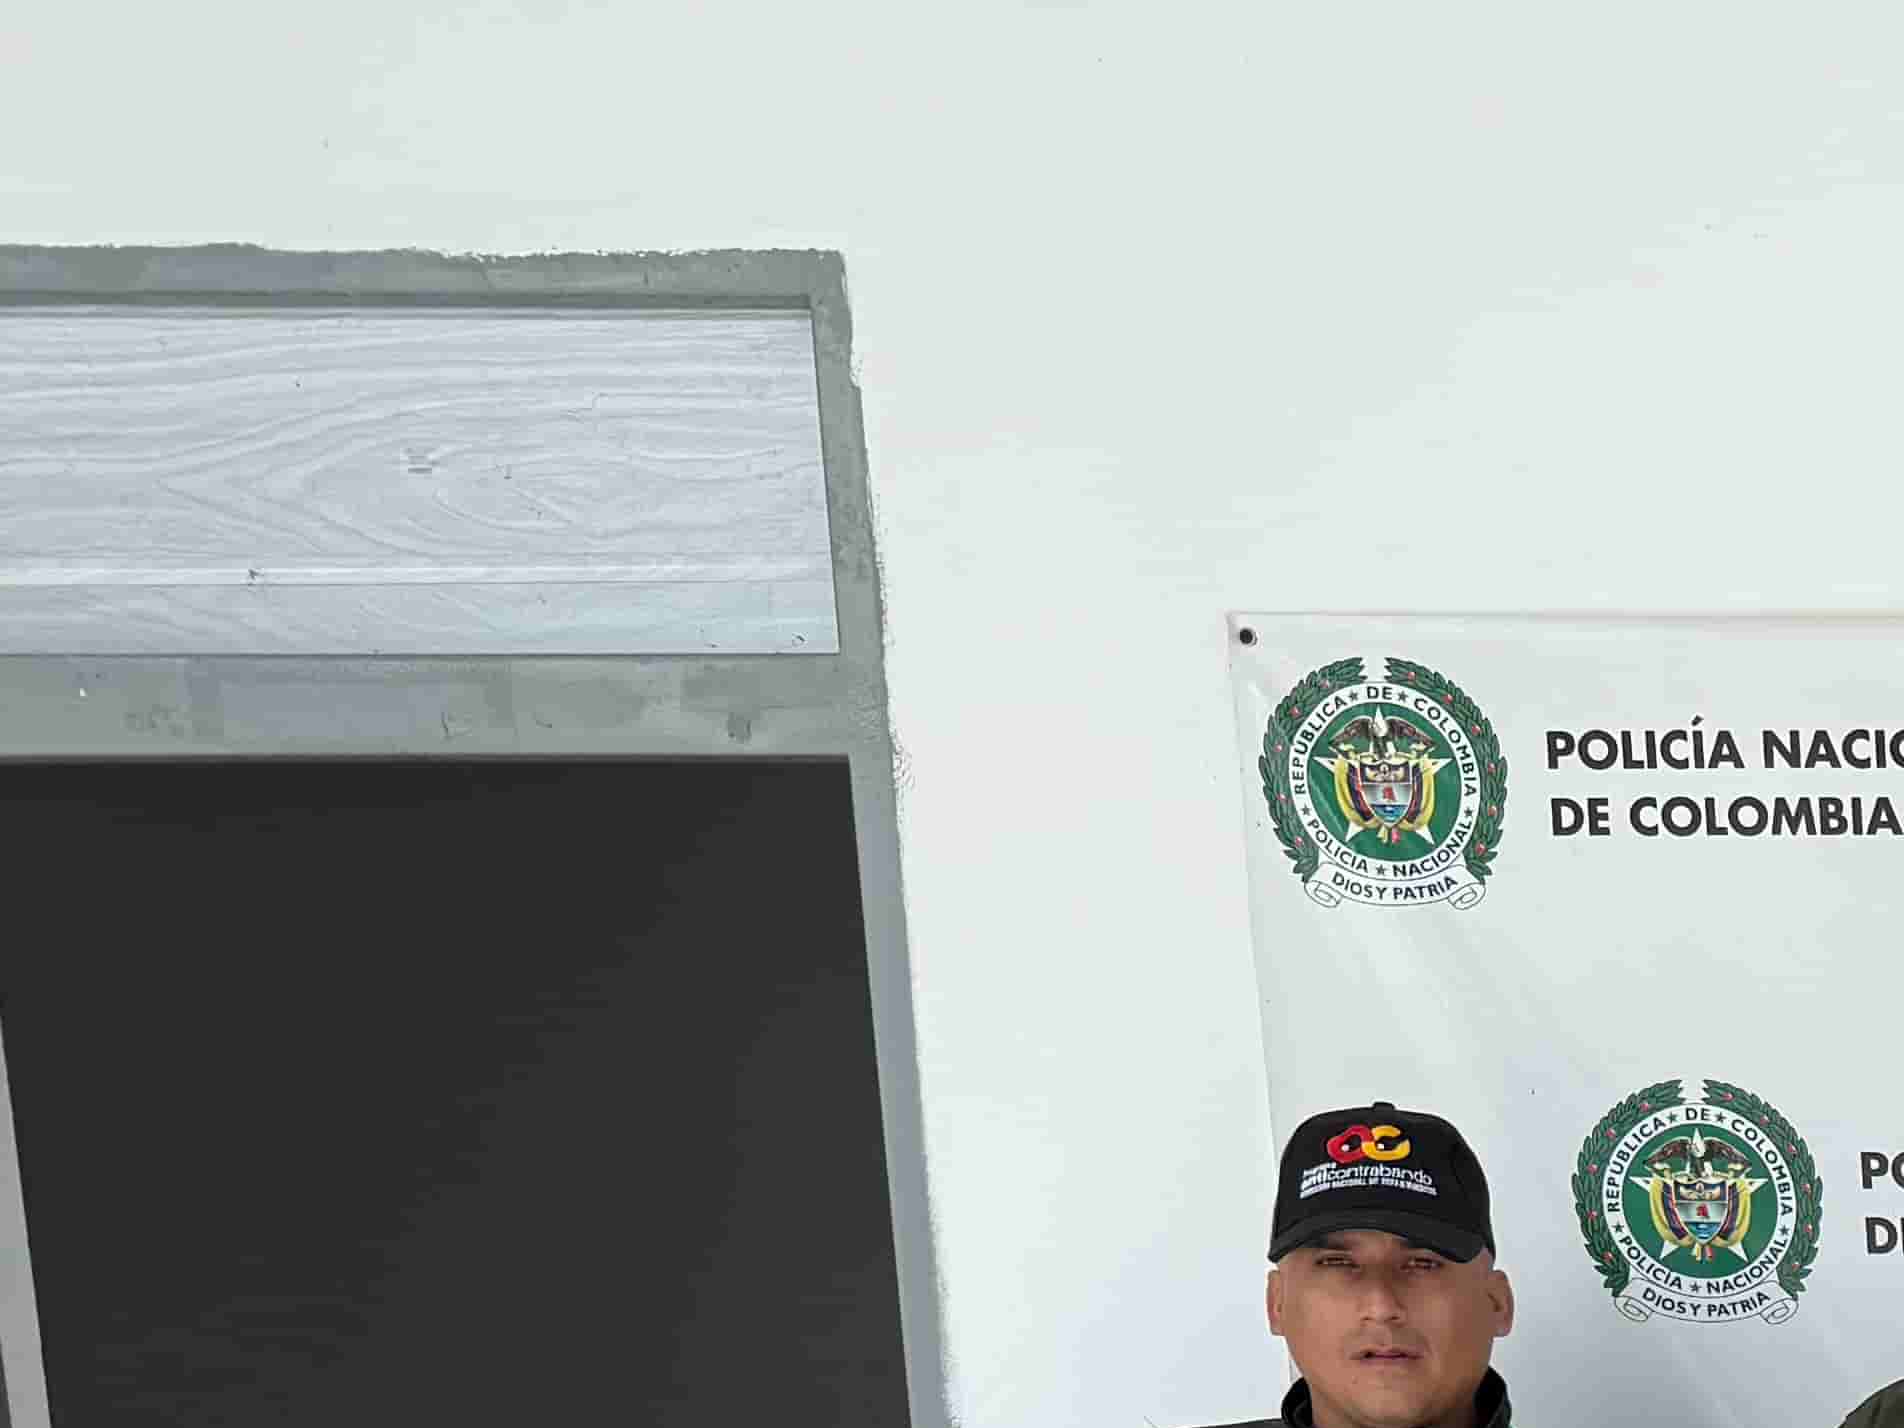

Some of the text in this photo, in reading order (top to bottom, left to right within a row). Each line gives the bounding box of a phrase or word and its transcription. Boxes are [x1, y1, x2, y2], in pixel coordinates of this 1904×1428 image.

[1294, 685, 1477, 797] REPUBLICA DE COLOMBIA
[1546, 715, 1745, 771] POLICÍA
[1550, 796, 1904, 837] DE COLOMBIA
[1307, 818, 1473, 878] POLICIA NACIONAL
[1392, 875, 1458, 901] PATRIA
